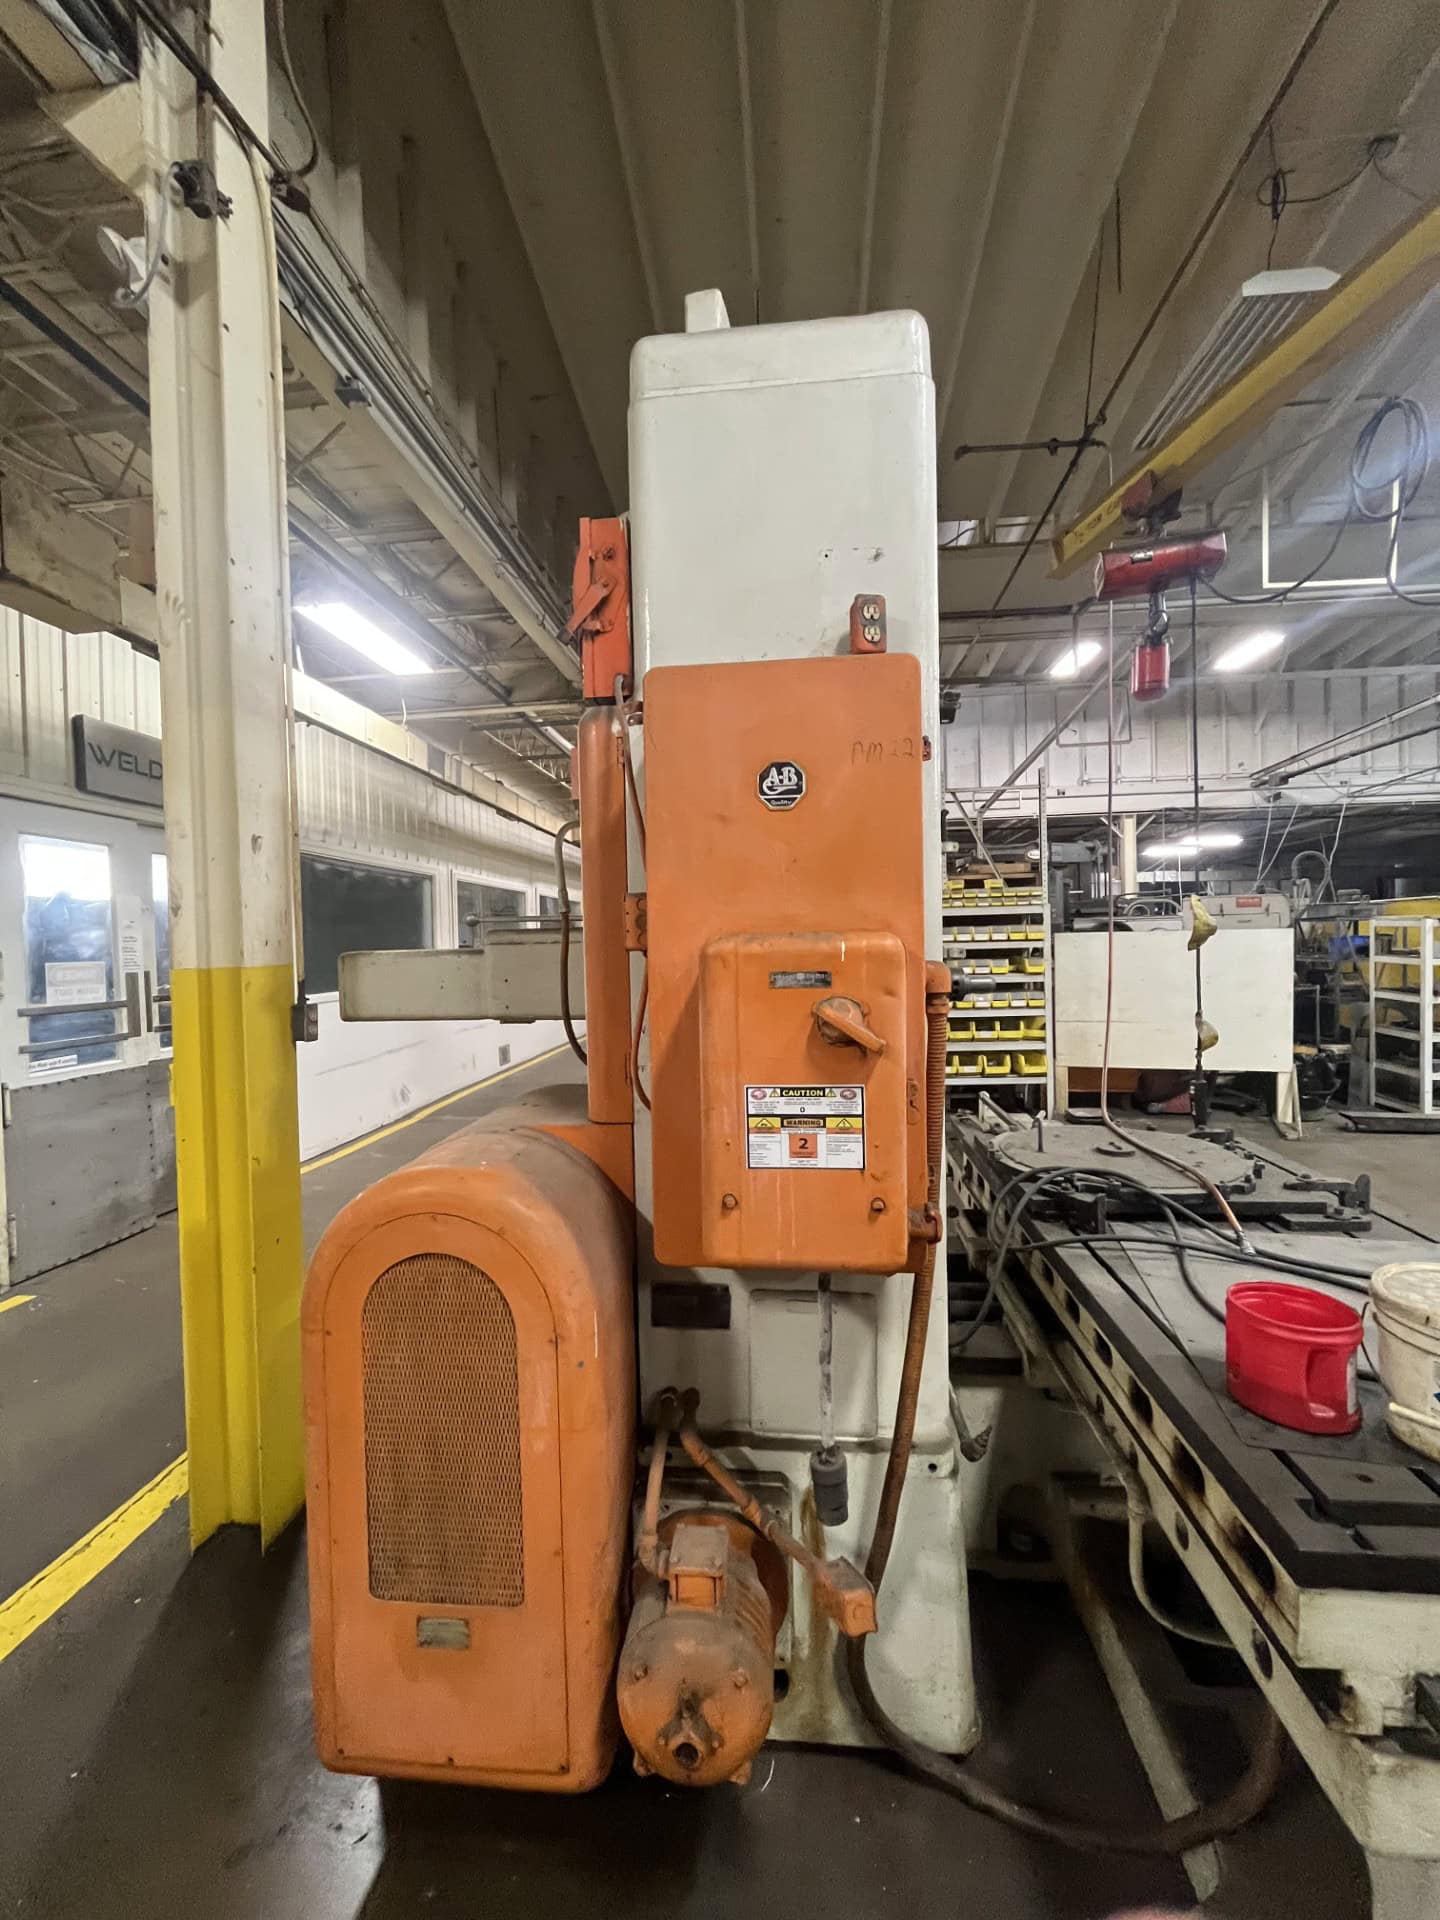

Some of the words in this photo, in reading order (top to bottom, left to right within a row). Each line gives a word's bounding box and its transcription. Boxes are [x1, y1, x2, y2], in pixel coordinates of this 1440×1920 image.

[87, 742, 163, 780] WELD
[782, 1089, 824, 1097] CAUTION
[798, 1137, 809, 1150] 2
